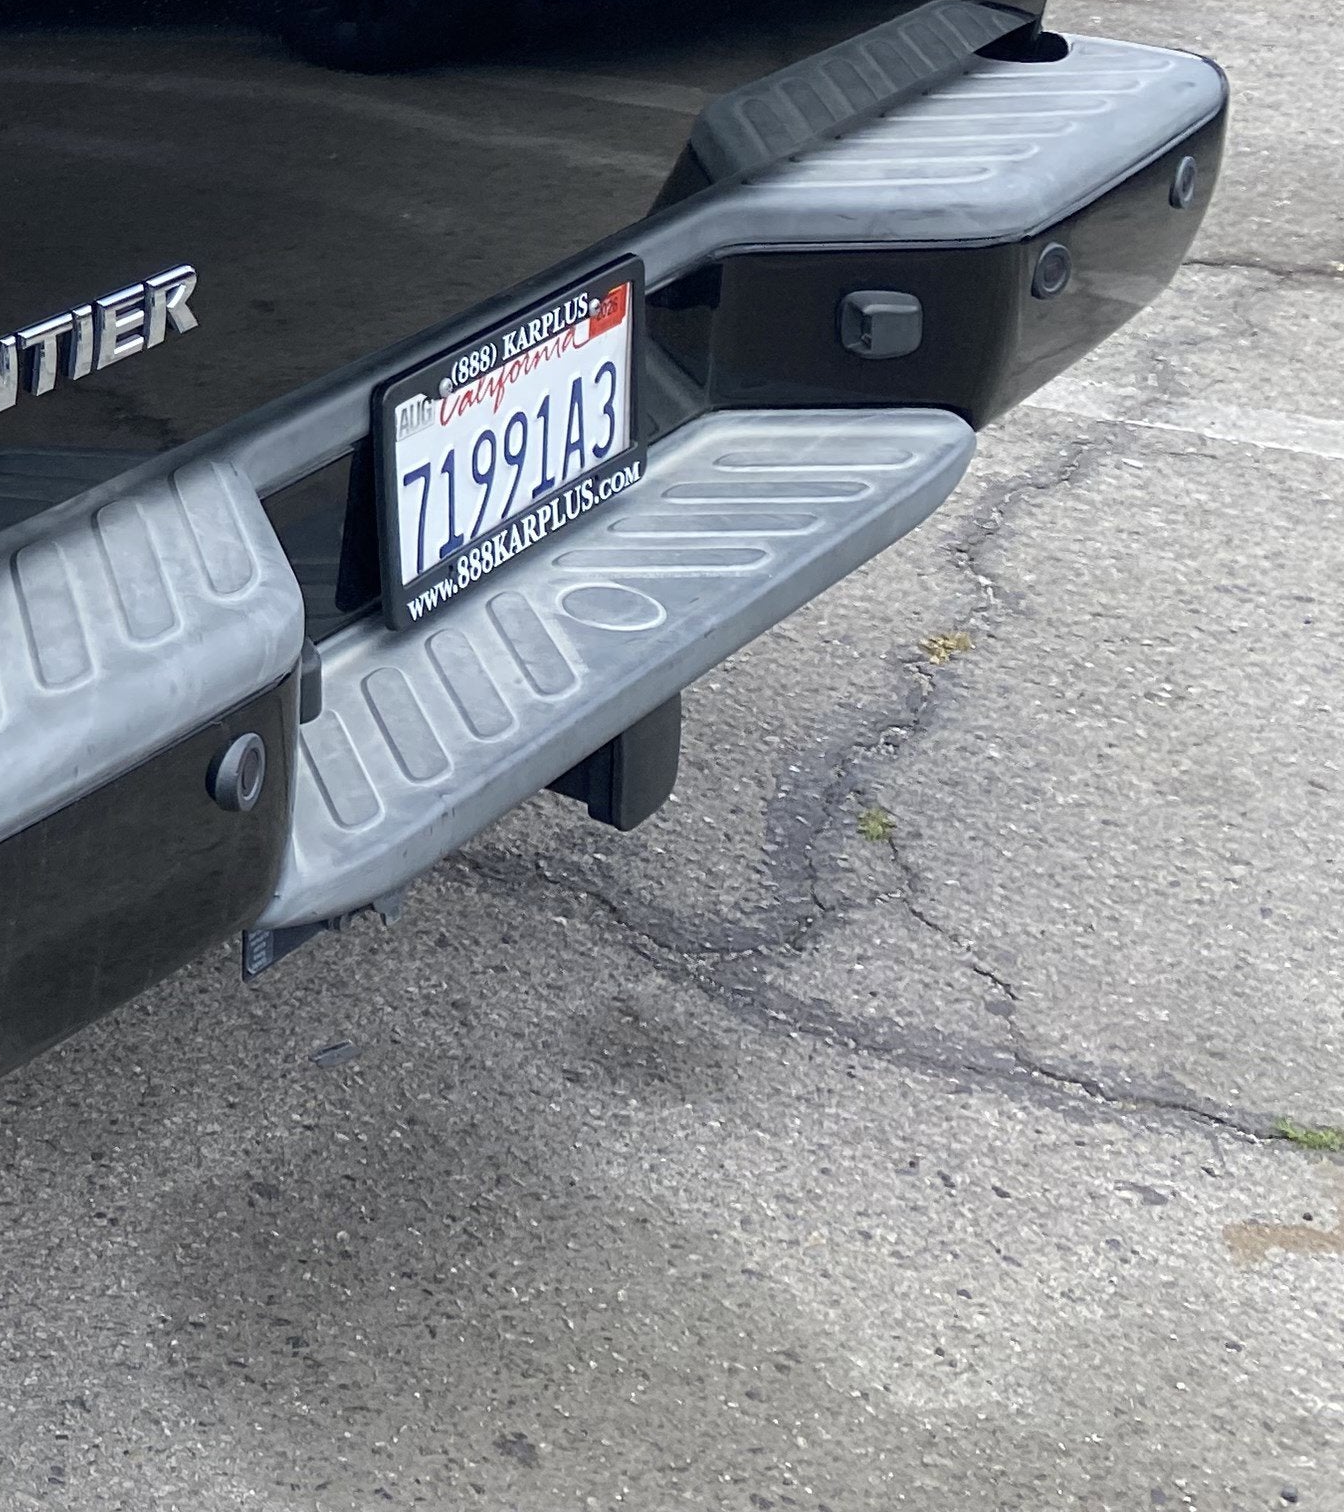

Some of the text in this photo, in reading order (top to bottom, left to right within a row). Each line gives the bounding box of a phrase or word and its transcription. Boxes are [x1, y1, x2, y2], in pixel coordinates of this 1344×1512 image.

[439, 328, 588, 426] California
[450, 291, 590, 387] (888) KARPLUS
[399, 400, 433, 438] AUG
[402, 360, 618, 575] 71991A3
[405, 460, 642, 622] www.888KARPLUS.COM
